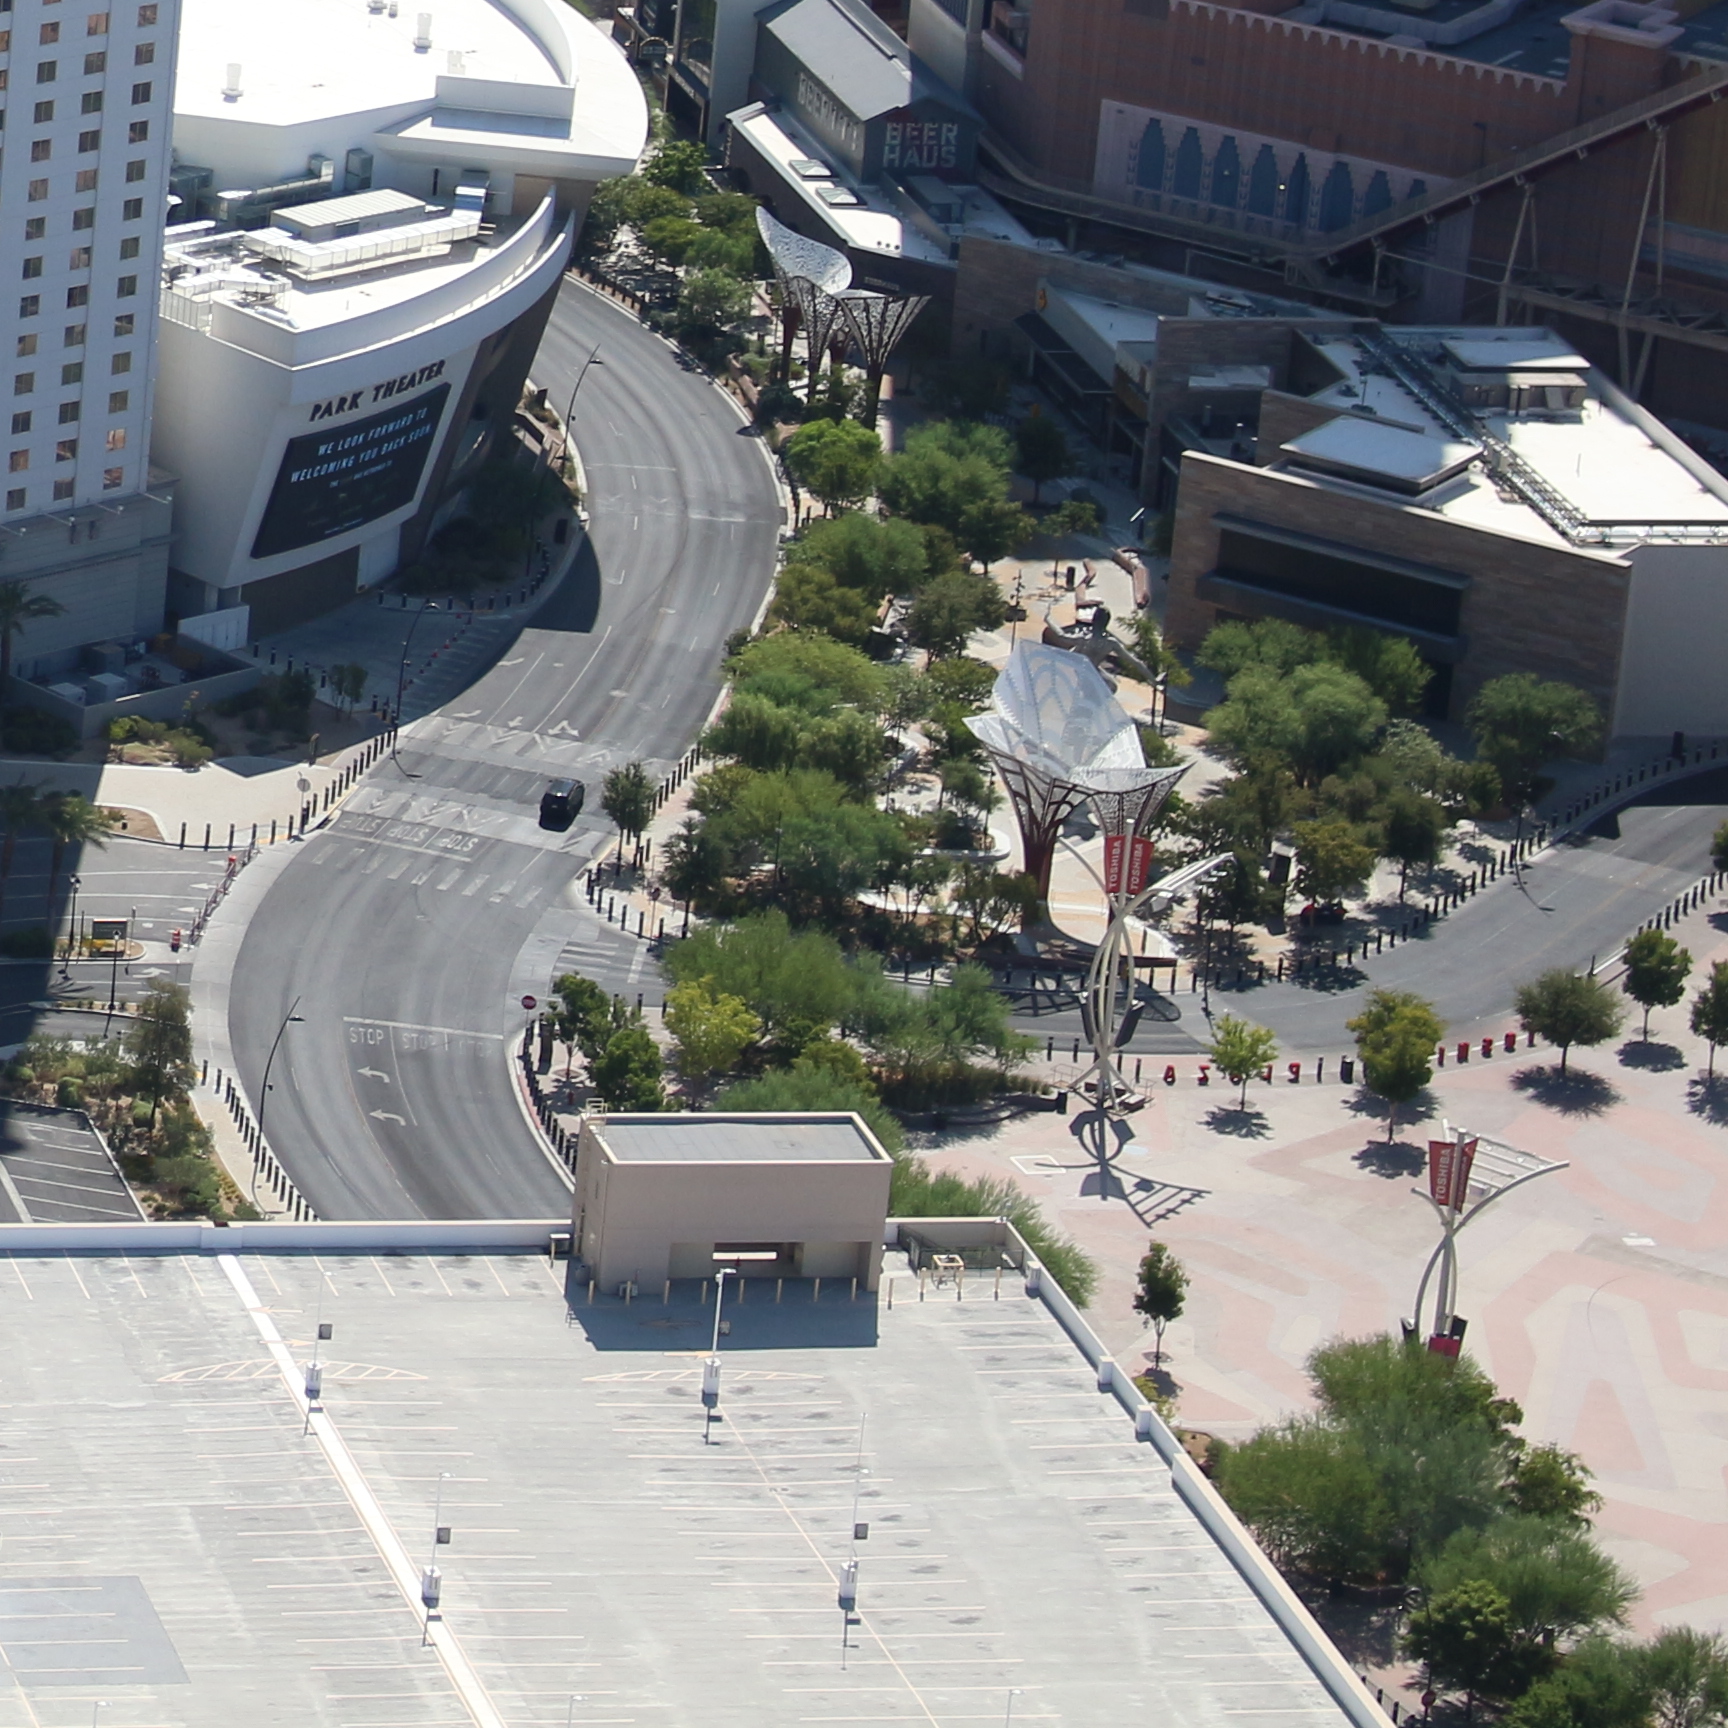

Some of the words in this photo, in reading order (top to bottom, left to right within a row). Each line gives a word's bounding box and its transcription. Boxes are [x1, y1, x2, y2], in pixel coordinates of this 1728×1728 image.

[883, 146, 957, 169] HAUS
[886, 122, 957, 147] BEER
[309, 391, 364, 422] PARK
[372, 359, 446, 403] THEATER
[291, 455, 356, 484] WELCOMING
[359, 447, 379, 464] YOU
[381, 435, 406, 455] BACK
[317, 441, 335, 457] WE
[338, 432, 365, 451] LOOK
[368, 414, 414, 441] FORWARD
[1109, 839, 1122, 888] TOSHIBA
[1130, 843, 1144, 891] TOSHIBA
[348, 1027, 385, 1046] STOP
[1435, 1148, 1451, 1201] TOSHIBA
